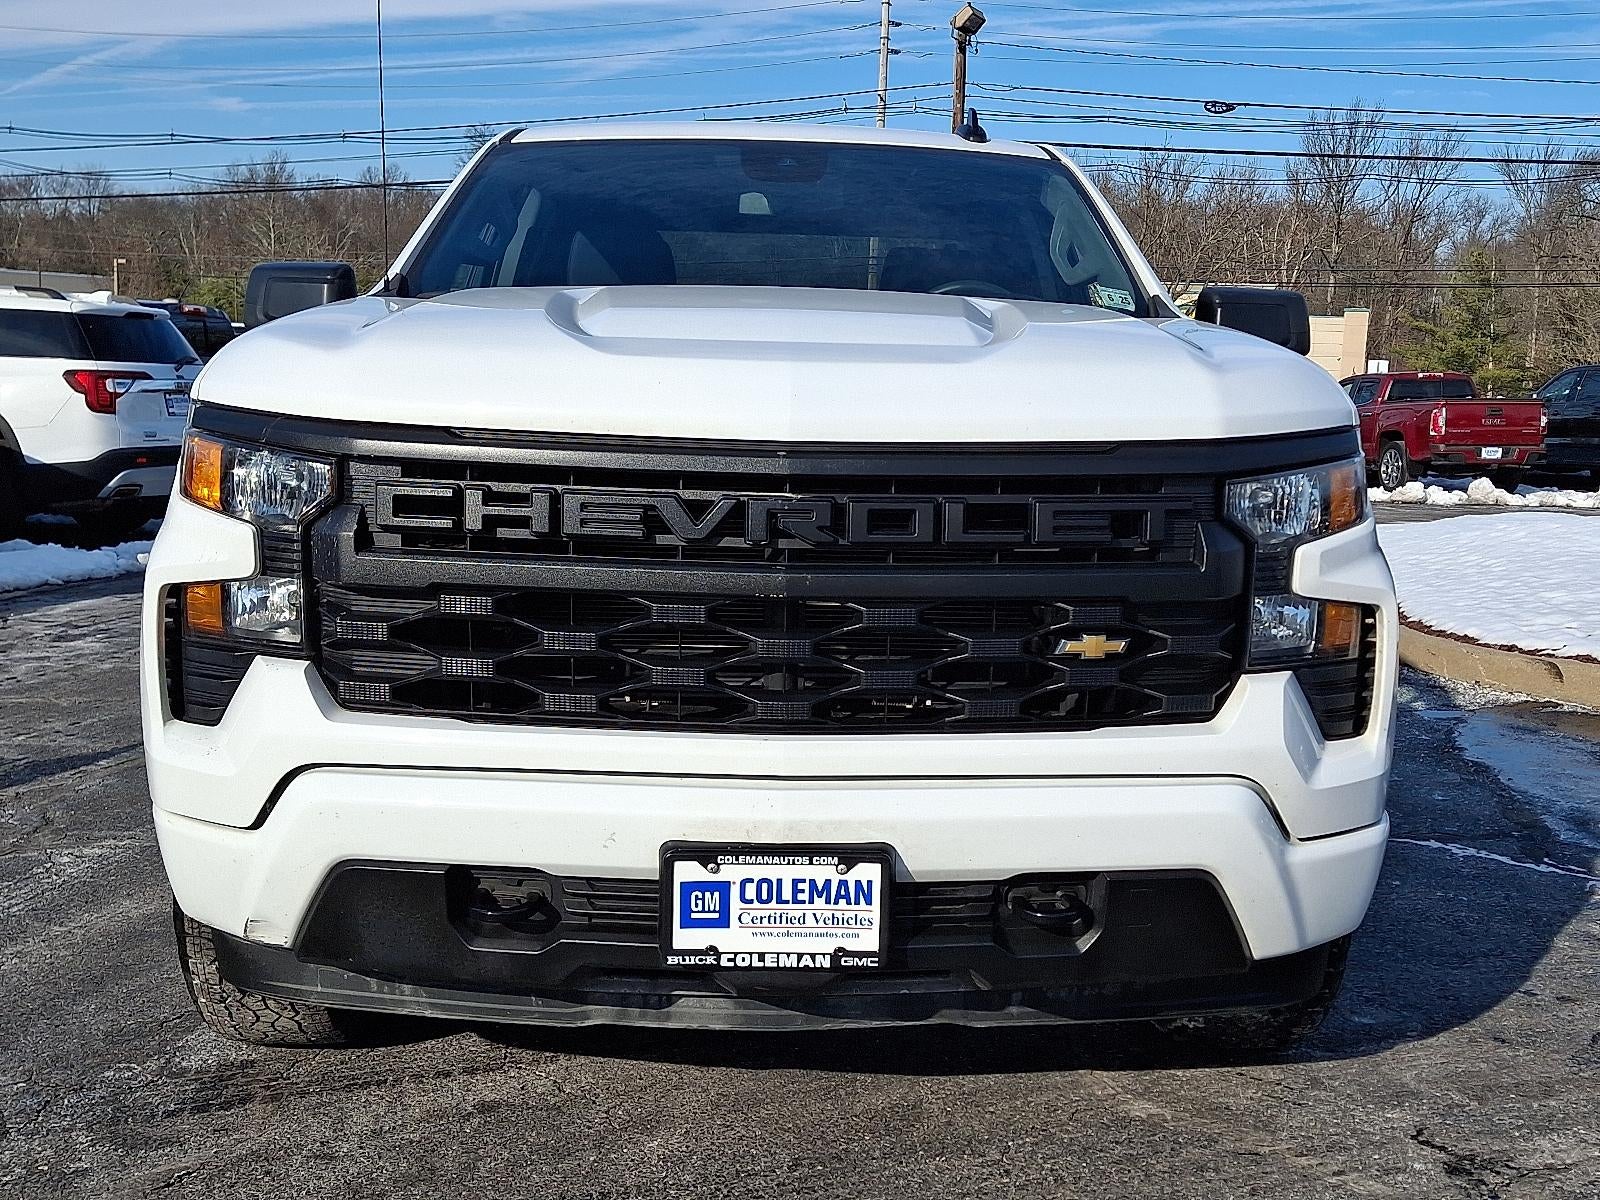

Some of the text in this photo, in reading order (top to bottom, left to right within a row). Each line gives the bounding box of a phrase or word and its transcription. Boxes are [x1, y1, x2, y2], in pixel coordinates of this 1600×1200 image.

[1107, 293, 1131, 305] 6 25
[375, 480, 1193, 545] CHEVROLET
[717, 855, 809, 865] COLEMANAUTOS
[739, 878, 873, 905] COLEMAN
[690, 891, 720, 912] GM
[737, 911, 874, 927] Certified Vehicles
[751, 930, 860, 939] www.colemanautos.com
[666, 953, 879, 968] BUICK COLEMAN GMC
